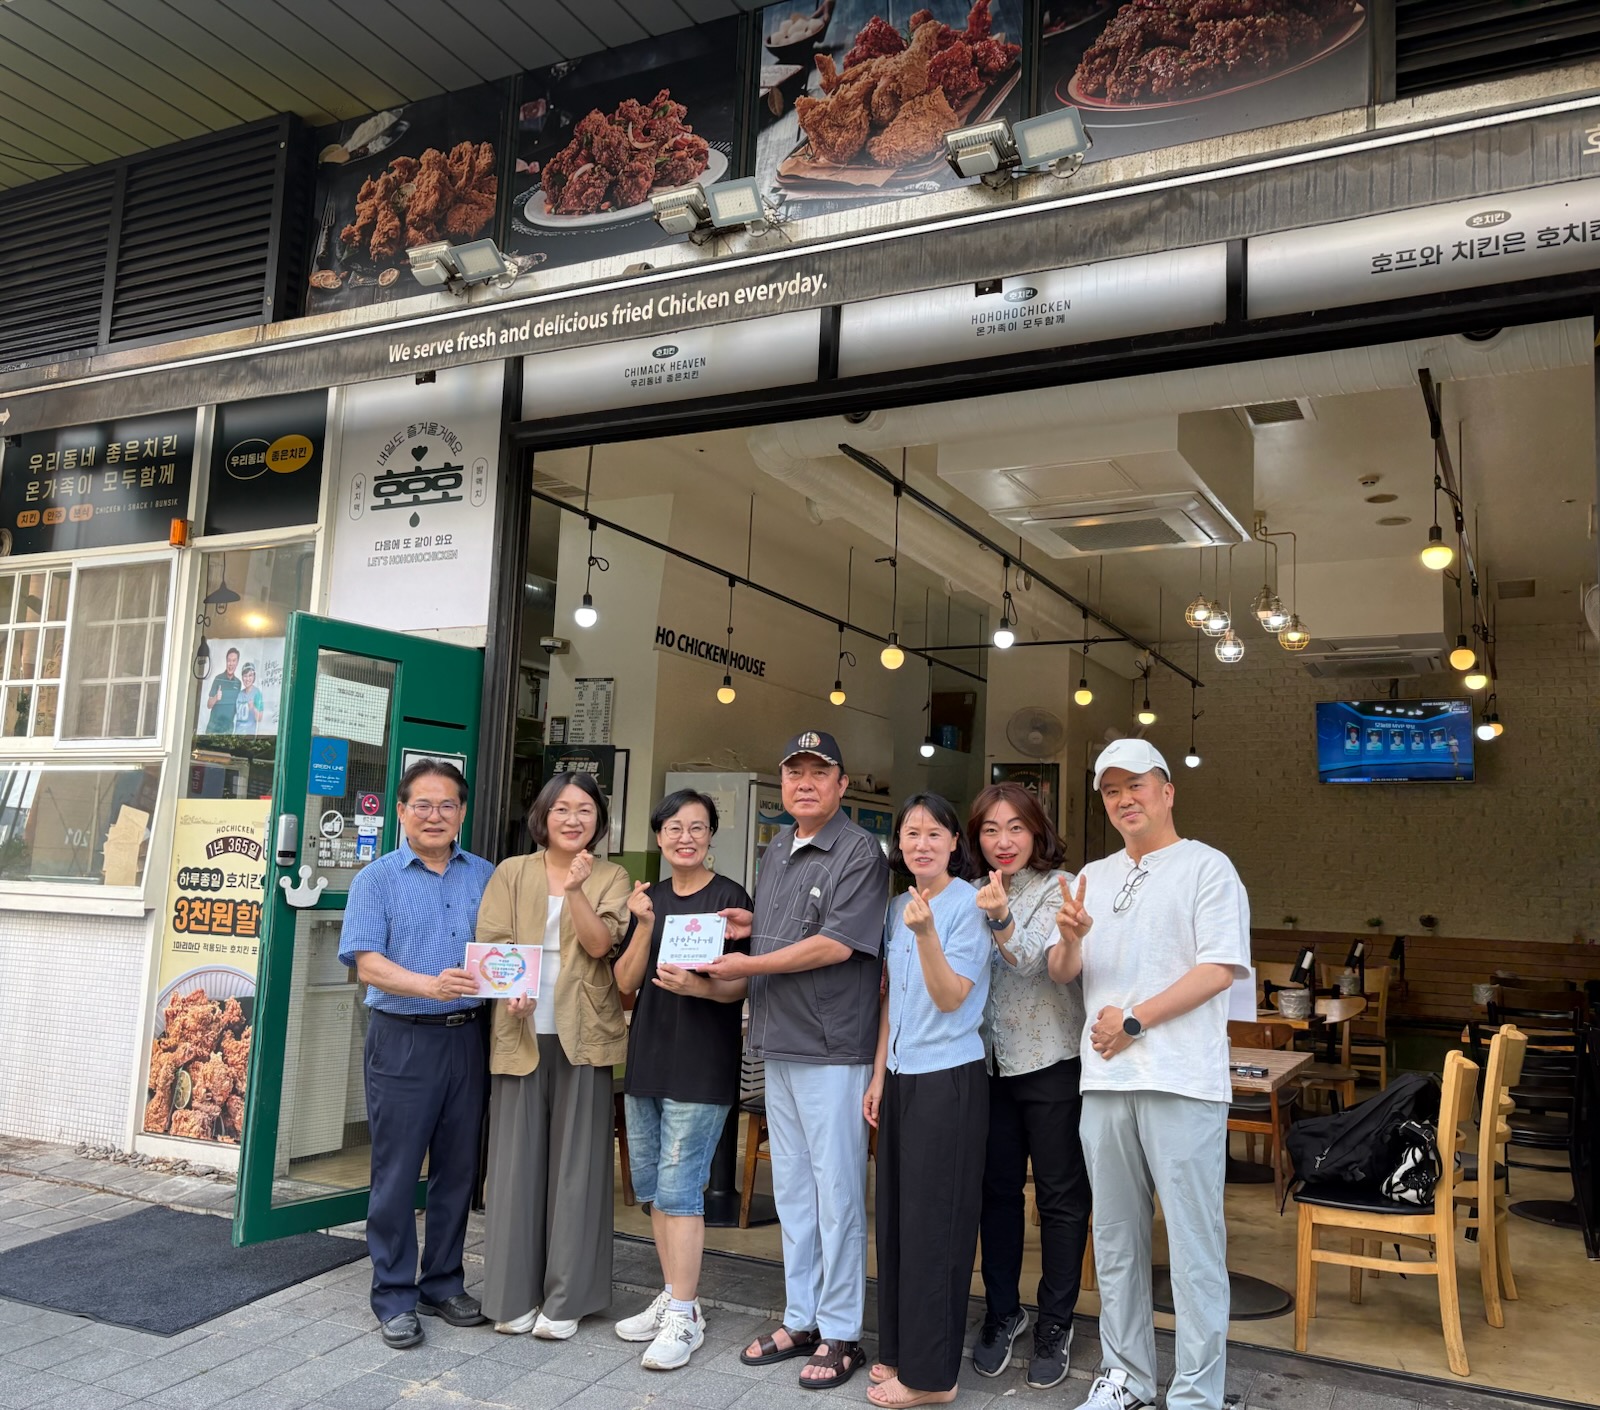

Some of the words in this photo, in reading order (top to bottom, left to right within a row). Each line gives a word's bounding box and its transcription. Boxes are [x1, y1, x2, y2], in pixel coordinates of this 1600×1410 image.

[1472, 213, 1505, 227] 호치킨
[1370, 244, 1444, 274] 호프와
[1452, 231, 1526, 261] 치킨은
[1009, 290, 1034, 300] 호치킨
[388, 342, 412, 363] We
[413, 337, 454, 359] serve
[457, 329, 497, 352] fresh
[499, 319, 530, 345] and
[533, 309, 607, 340] delicious
[611, 298, 654, 327] fried
[657, 290, 730, 318] Chicken
[733, 272, 828, 304] everyday.
[972, 300, 1071, 324] HOHOHOCHICKEN
[976, 322, 1017, 336] 온가족이
[1022, 314, 1065, 330] 모두함께
[656, 347, 676, 357] 호치킨
[625, 362, 666, 378] CHIMACK
[670, 357, 706, 372] HEAVEN
[630, 376, 662, 388] 우리동네
[666, 370, 700, 383] 좋은치킨
[29, 446, 96, 474] 우리동네
[106, 434, 178, 464] 좋은치킨
[230, 450, 266, 468] 우리동네
[271, 447, 307, 462] 좋은치킨
[376, 431, 406, 467] 내일도
[26, 474, 92, 502] 온가족이
[102, 463, 175, 491] 모두함께
[96, 505, 120, 514] CHICKEN
[128, 502, 148, 512] SNACK
[155, 498, 178, 508] BUNSIK
[20, 512, 36, 524] 치킨
[374, 538, 400, 552] 다음에
[402, 537, 412, 550] 또
[414, 536, 432, 548] 같이
[435, 534, 453, 546] 와요
[367, 553, 388, 568] LET'S
[388, 550, 458, 566] HOHOHOCHICKEN
[656, 626, 675, 648] HO
[677, 634, 728, 666] CHICKEN
[729, 652, 766, 678] HOUSE
[216, 825, 255, 834] HOCHICKEN
[208, 838, 226, 857] 1년
[228, 838, 261, 858] 365일
[180, 871, 222, 889] 하루종일
[175, 899, 234, 934] 3천원
[236, 901, 262, 936] 할
[173, 941, 200, 950] 1마리마다
[202, 943, 228, 953] 적용되는
[230, 945, 250, 954] 호치킨
